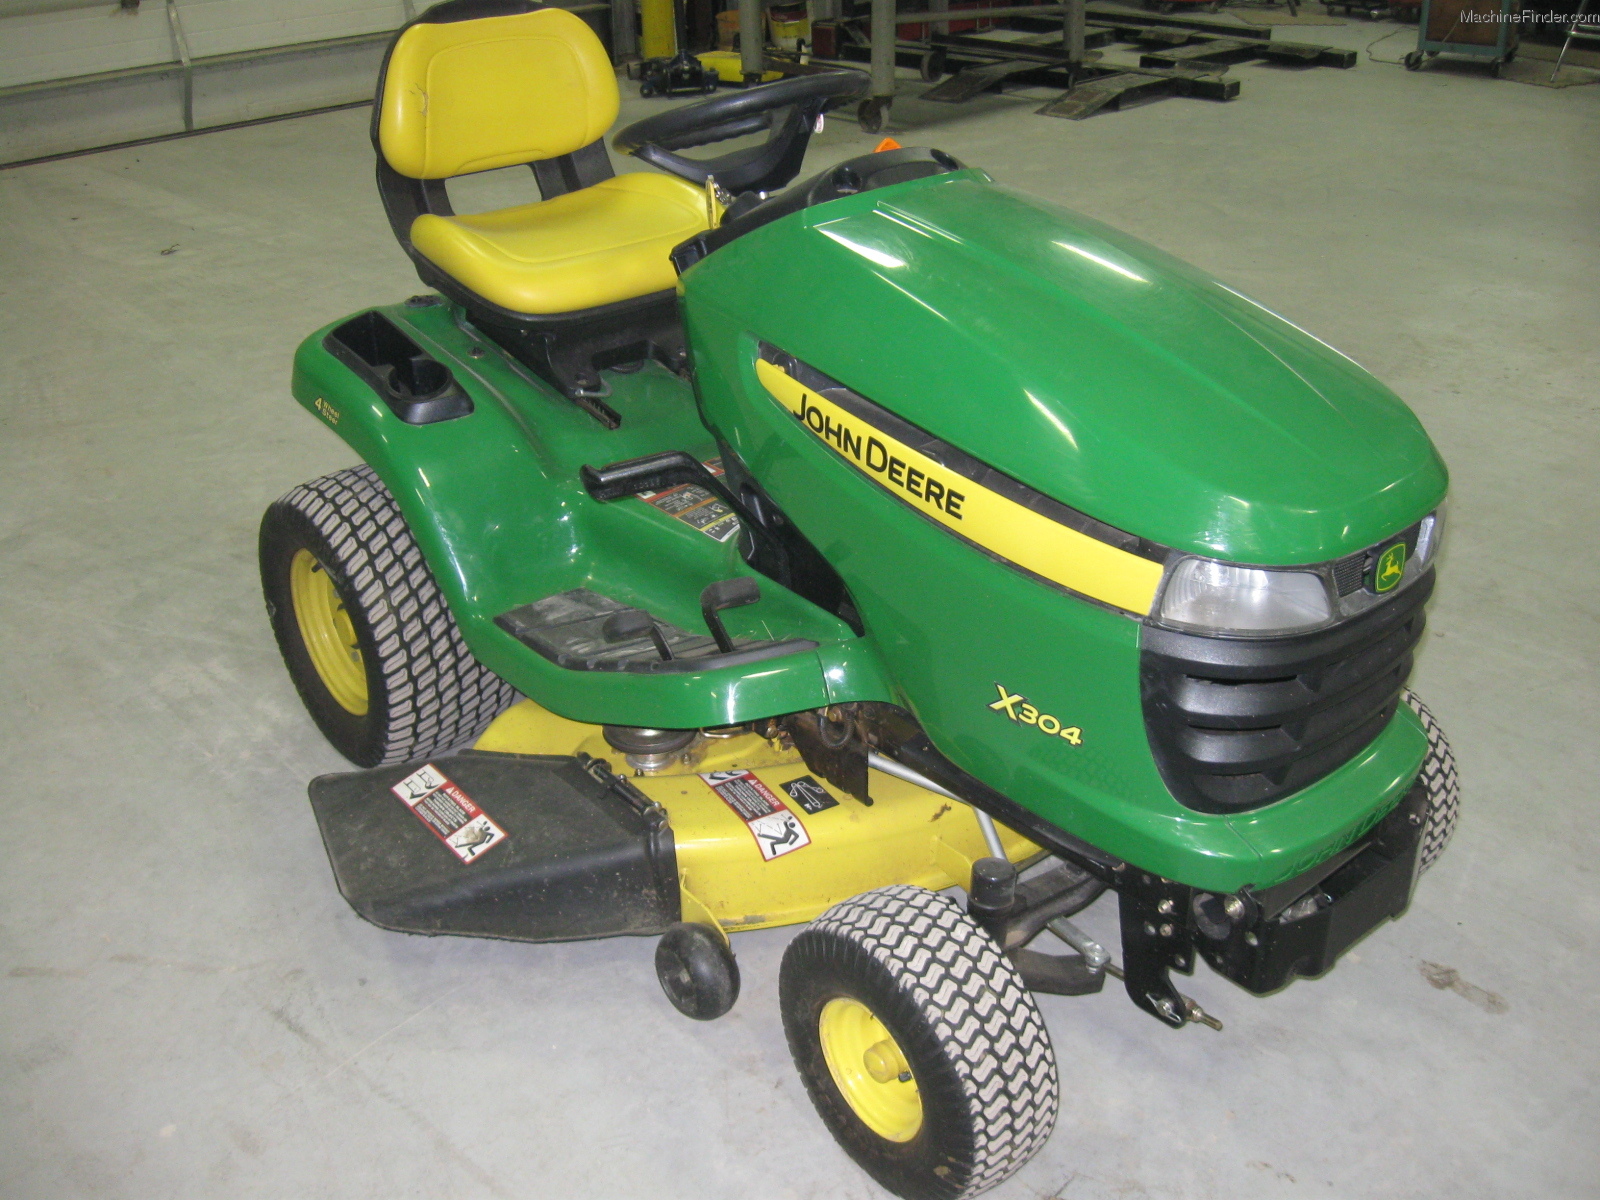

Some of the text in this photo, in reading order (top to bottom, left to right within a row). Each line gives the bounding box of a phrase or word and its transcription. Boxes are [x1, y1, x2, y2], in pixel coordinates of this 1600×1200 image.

[314, 397, 322, 411] 4
[793, 393, 965, 520] JOHN DEERE
[988, 683, 1083, 746] X304
[451, 791, 477, 813] DANGER
[754, 783, 780, 807] DANGER
